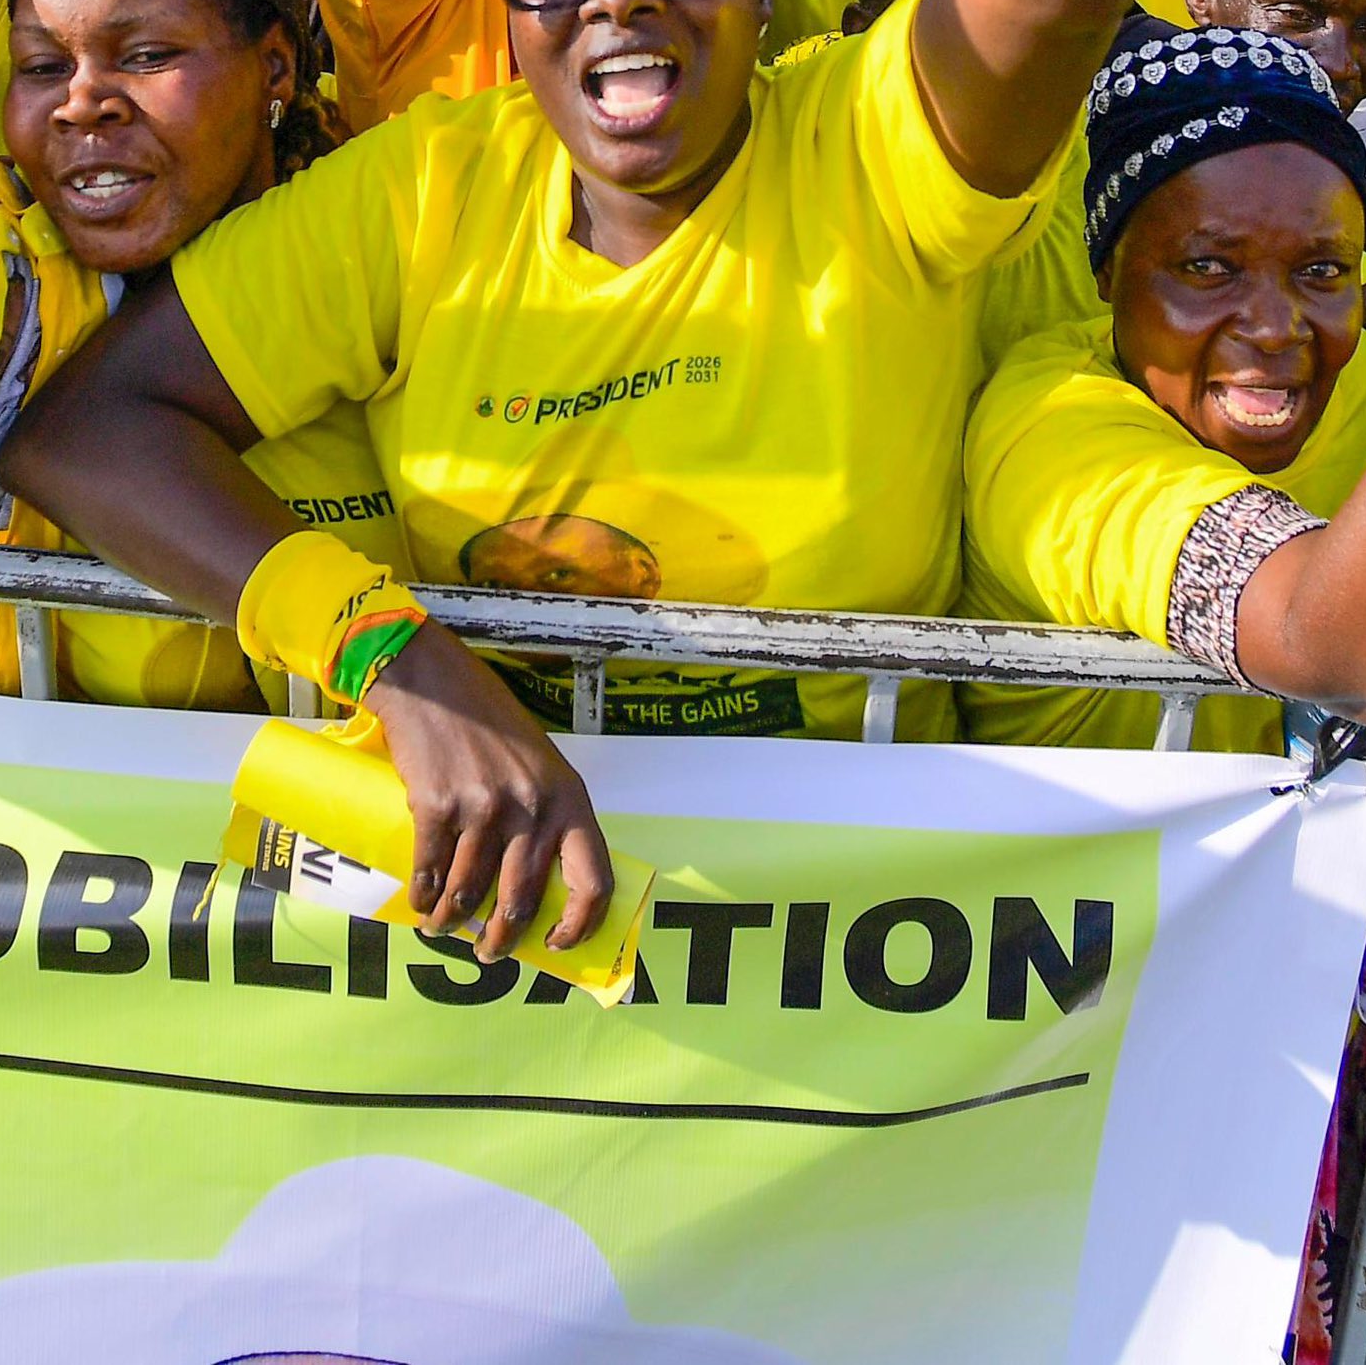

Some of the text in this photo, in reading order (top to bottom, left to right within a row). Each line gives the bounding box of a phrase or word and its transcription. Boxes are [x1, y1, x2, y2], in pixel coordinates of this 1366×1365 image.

[535, 356, 722, 425] PRESIDENT 2026
[685, 370, 720, 384] 2031
[624, 699, 675, 726] THE
[681, 689, 760, 724] GAINS
